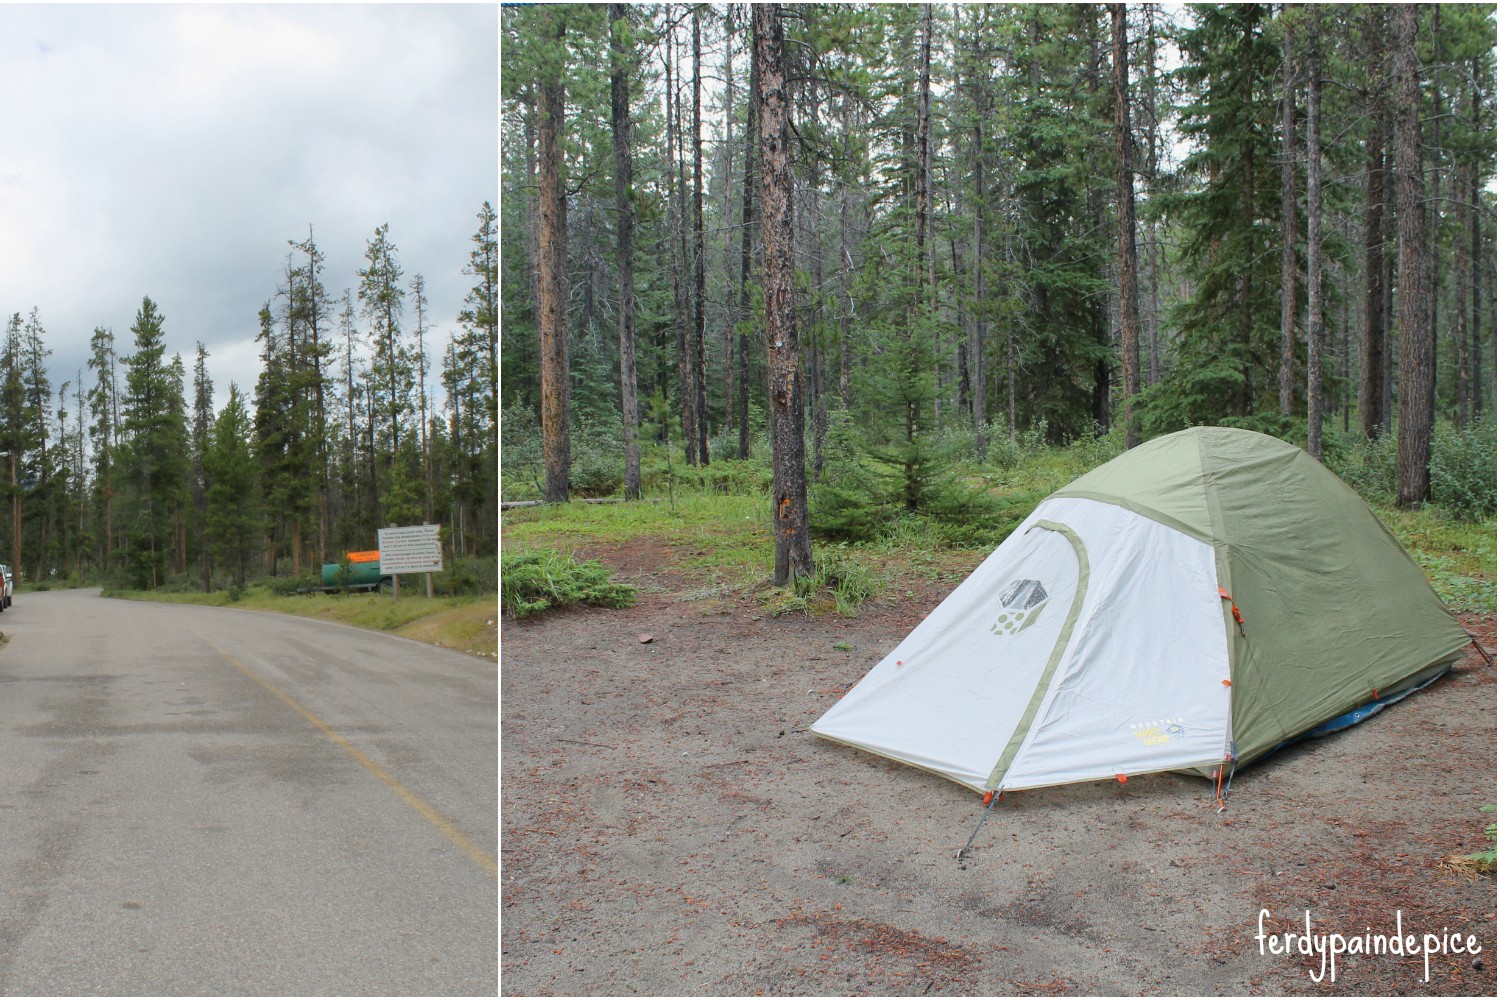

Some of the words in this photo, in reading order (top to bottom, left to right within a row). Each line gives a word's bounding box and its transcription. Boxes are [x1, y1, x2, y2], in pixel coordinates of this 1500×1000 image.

[1130, 717, 1184, 729] MOUNTAIN
[1135, 728, 1160, 739] HARD
[1143, 735, 1170, 746] WEAR
